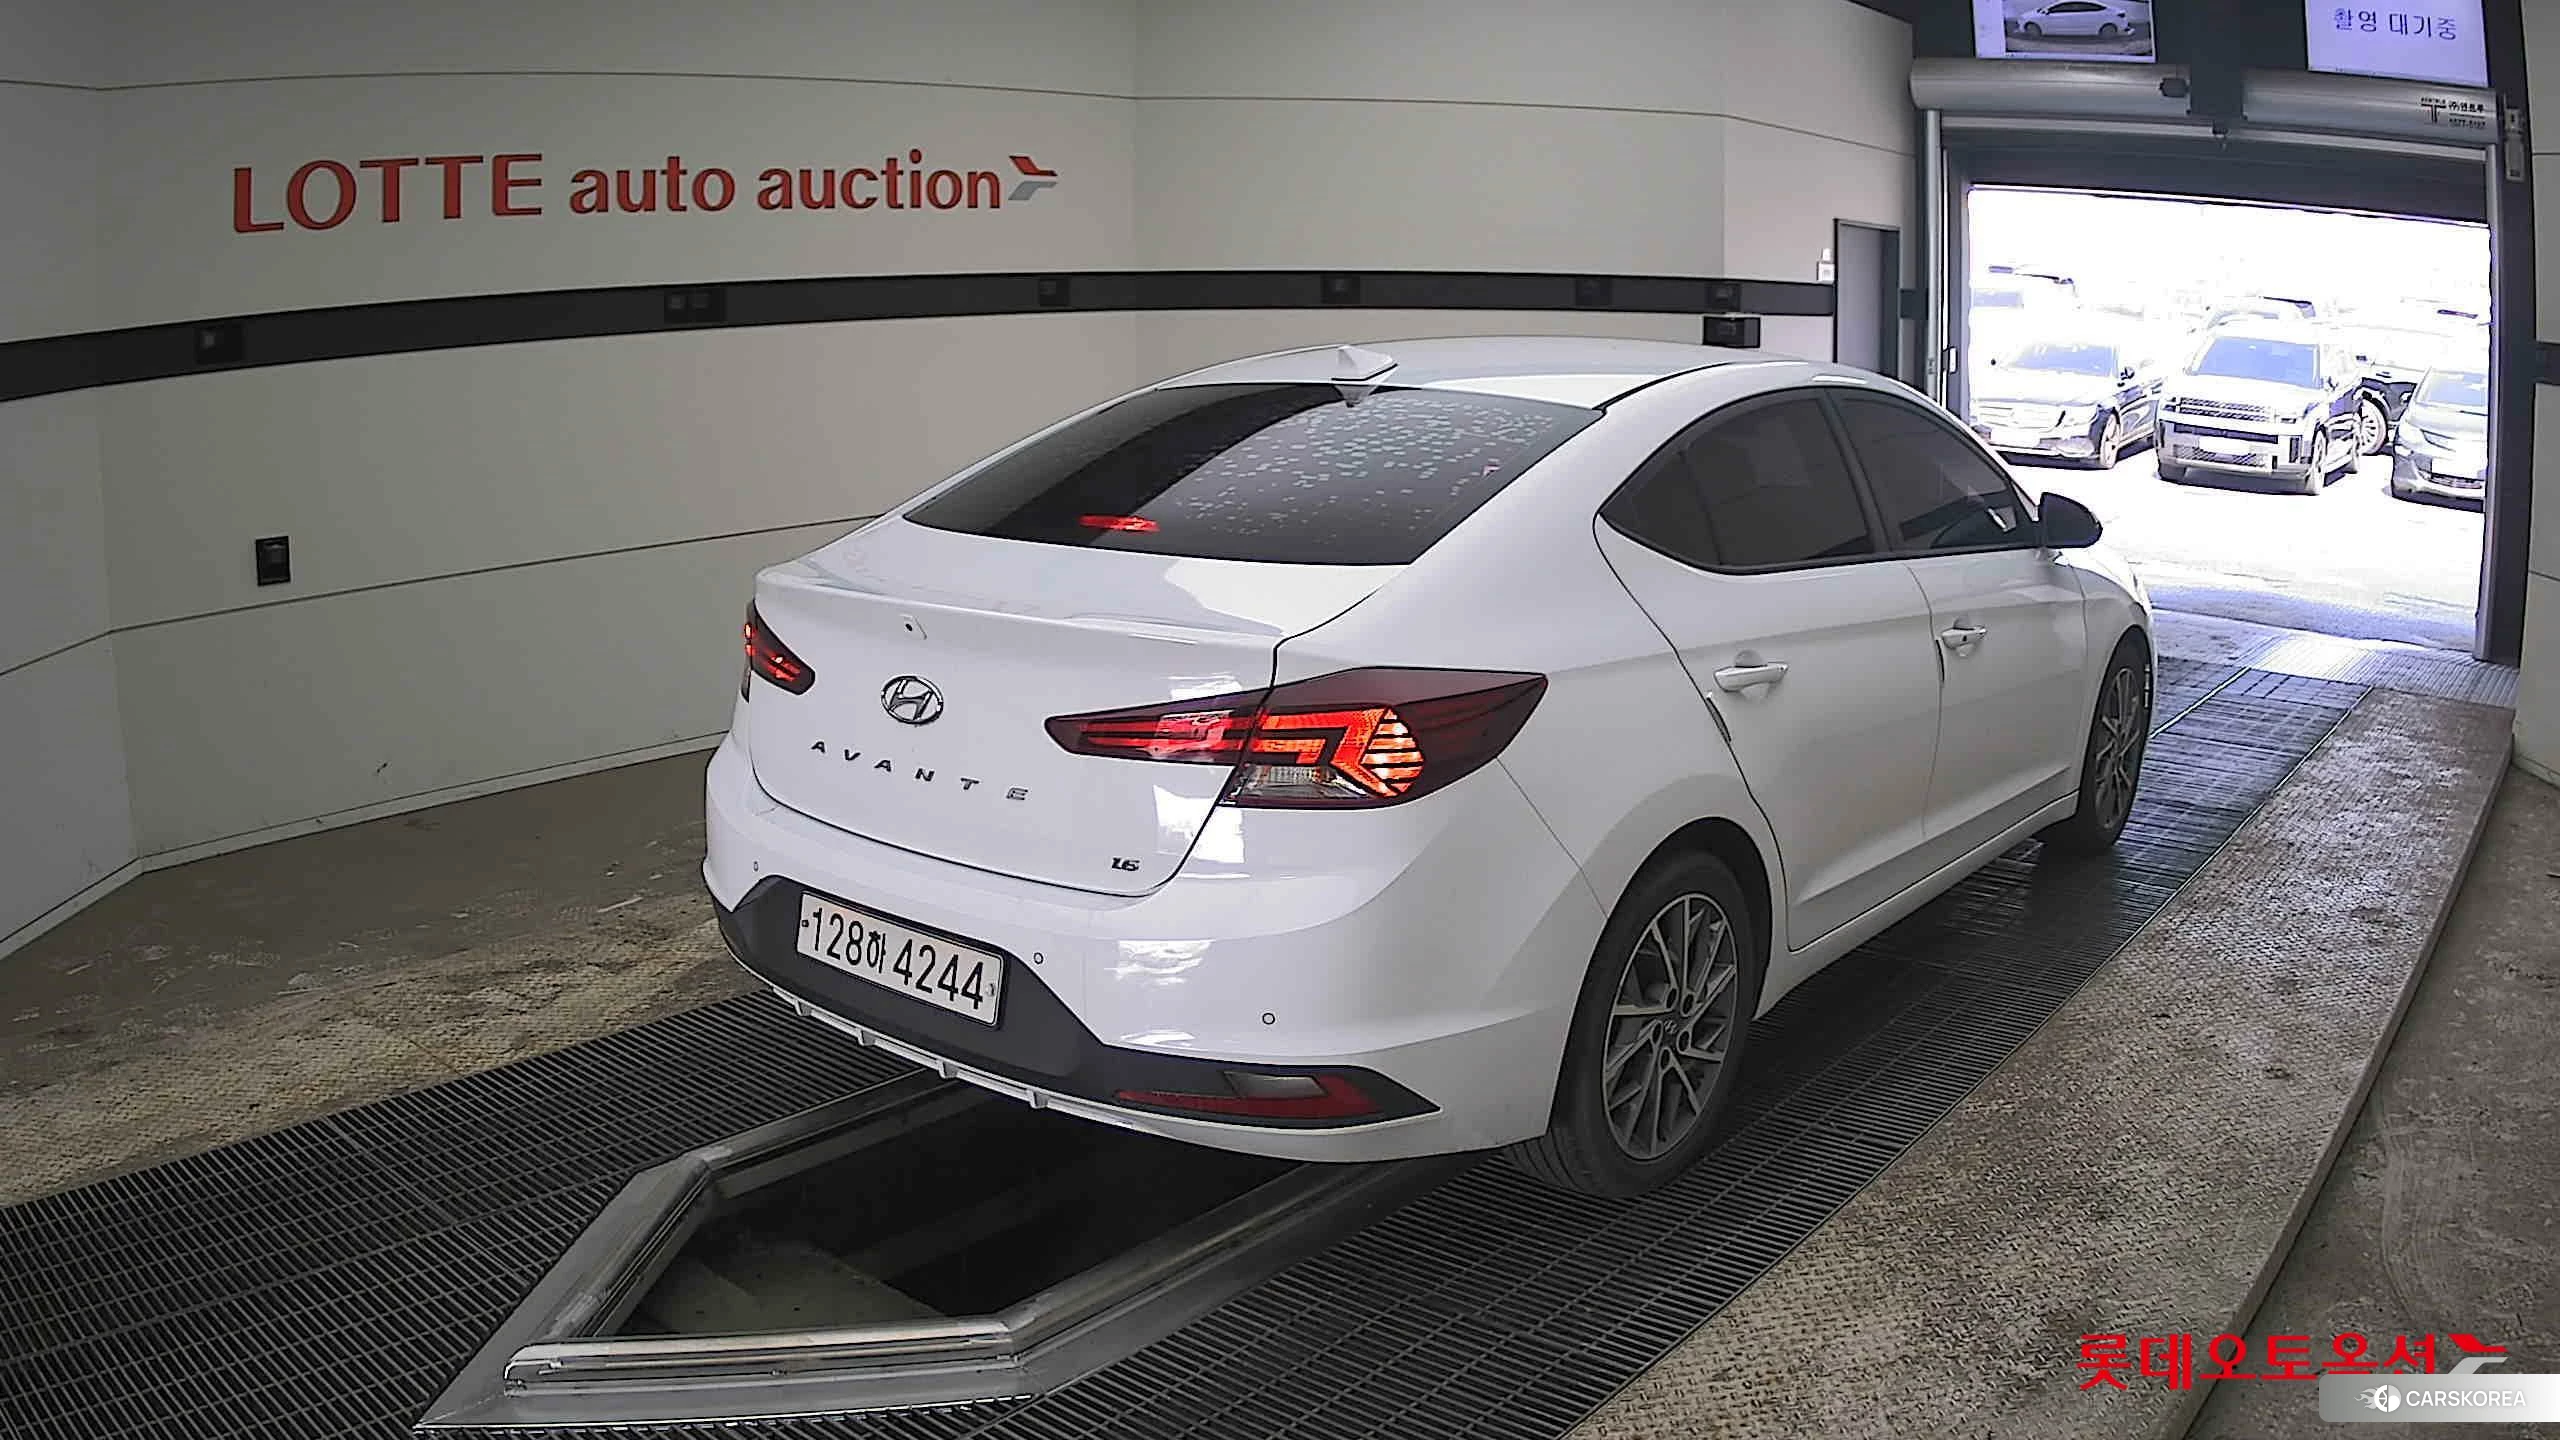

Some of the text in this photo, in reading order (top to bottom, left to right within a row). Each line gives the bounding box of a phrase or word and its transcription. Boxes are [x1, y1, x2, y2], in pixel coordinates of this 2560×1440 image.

[2389, 13, 2456, 40] 대기중
[234, 149, 1002, 233] LOTTE auto auction
[811, 740, 1029, 801] AVANTE
[813, 907, 984, 1010] 128하 4244
